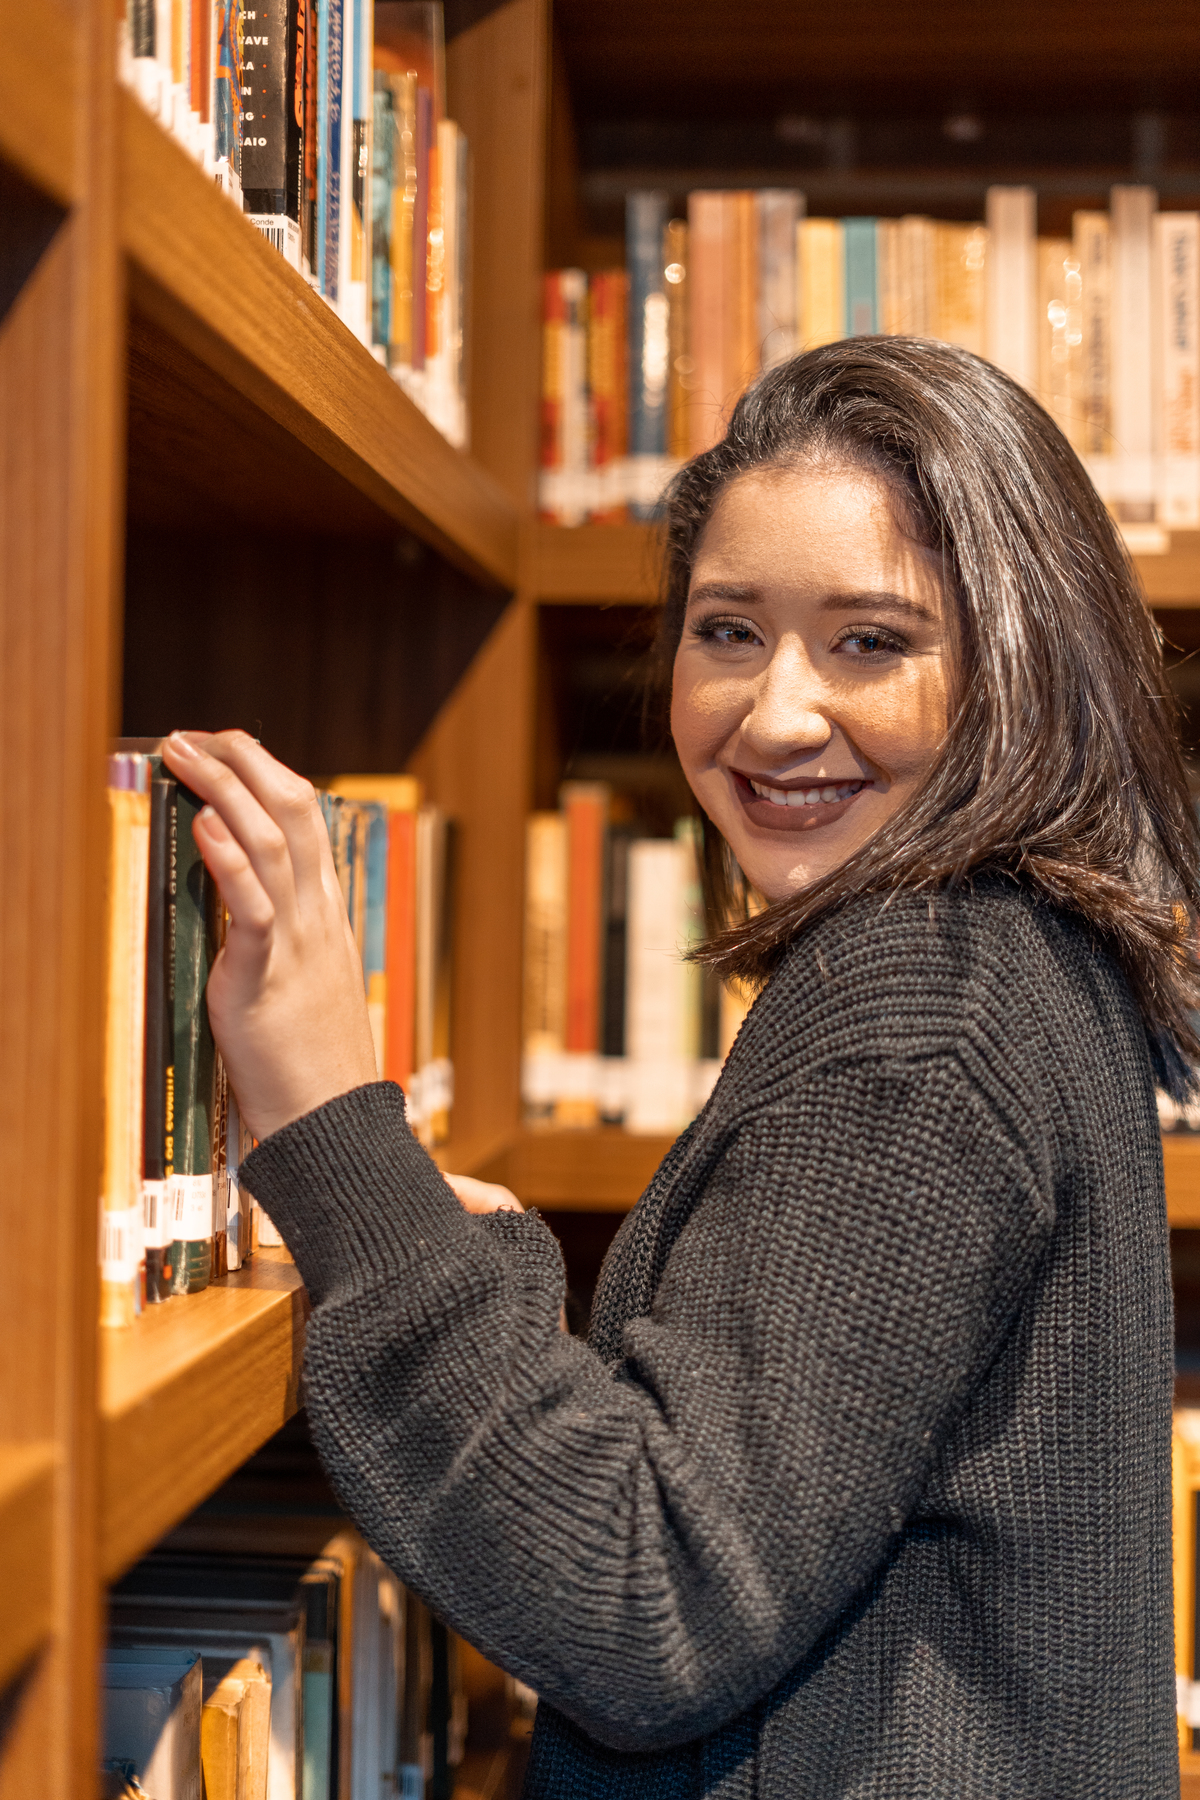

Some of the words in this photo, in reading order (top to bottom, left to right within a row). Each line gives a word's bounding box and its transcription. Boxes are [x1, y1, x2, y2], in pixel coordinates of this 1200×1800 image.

[250, 218, 274, 226] Conde
[169, 805, 177, 896] RICHARD
[164, 1135, 174, 1161] DO
